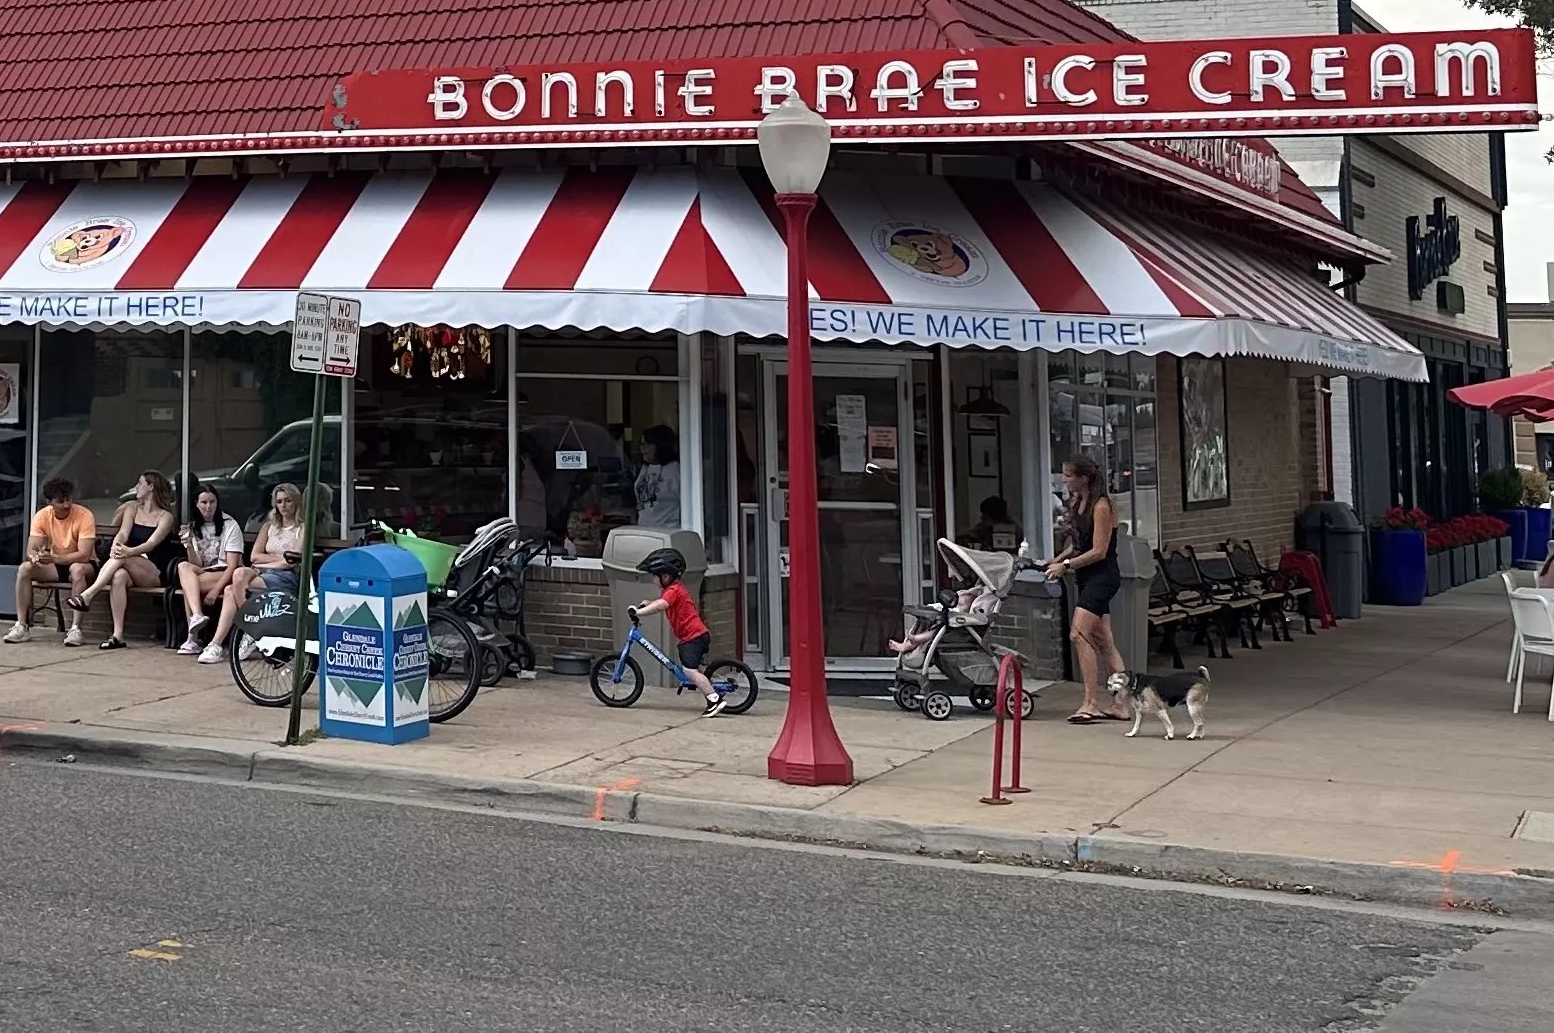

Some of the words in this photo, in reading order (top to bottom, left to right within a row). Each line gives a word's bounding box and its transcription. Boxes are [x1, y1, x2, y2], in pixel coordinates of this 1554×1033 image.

[427, 69, 716, 121] BONNIE
[754, 60, 980, 114] BRAE
[1024, 54, 1149, 107] ICE
[1189, 42, 1502, 105] CREAM
[20, 296, 87, 317] MAKE
[97, 296, 119, 317] IT
[126, 296, 204, 317] HERE!
[338, 302, 351, 317] NO
[329, 316, 358, 334] PARKING
[808, 307, 857, 333] ES!
[866, 311, 916, 336] WE
[926, 314, 1010, 342] MAKE
[1021, 318, 1046, 342] IT
[1056, 320, 1148, 347] HERE!
[333, 343, 349, 356] TIME
[326, 646, 385, 671] CHRONICLE
